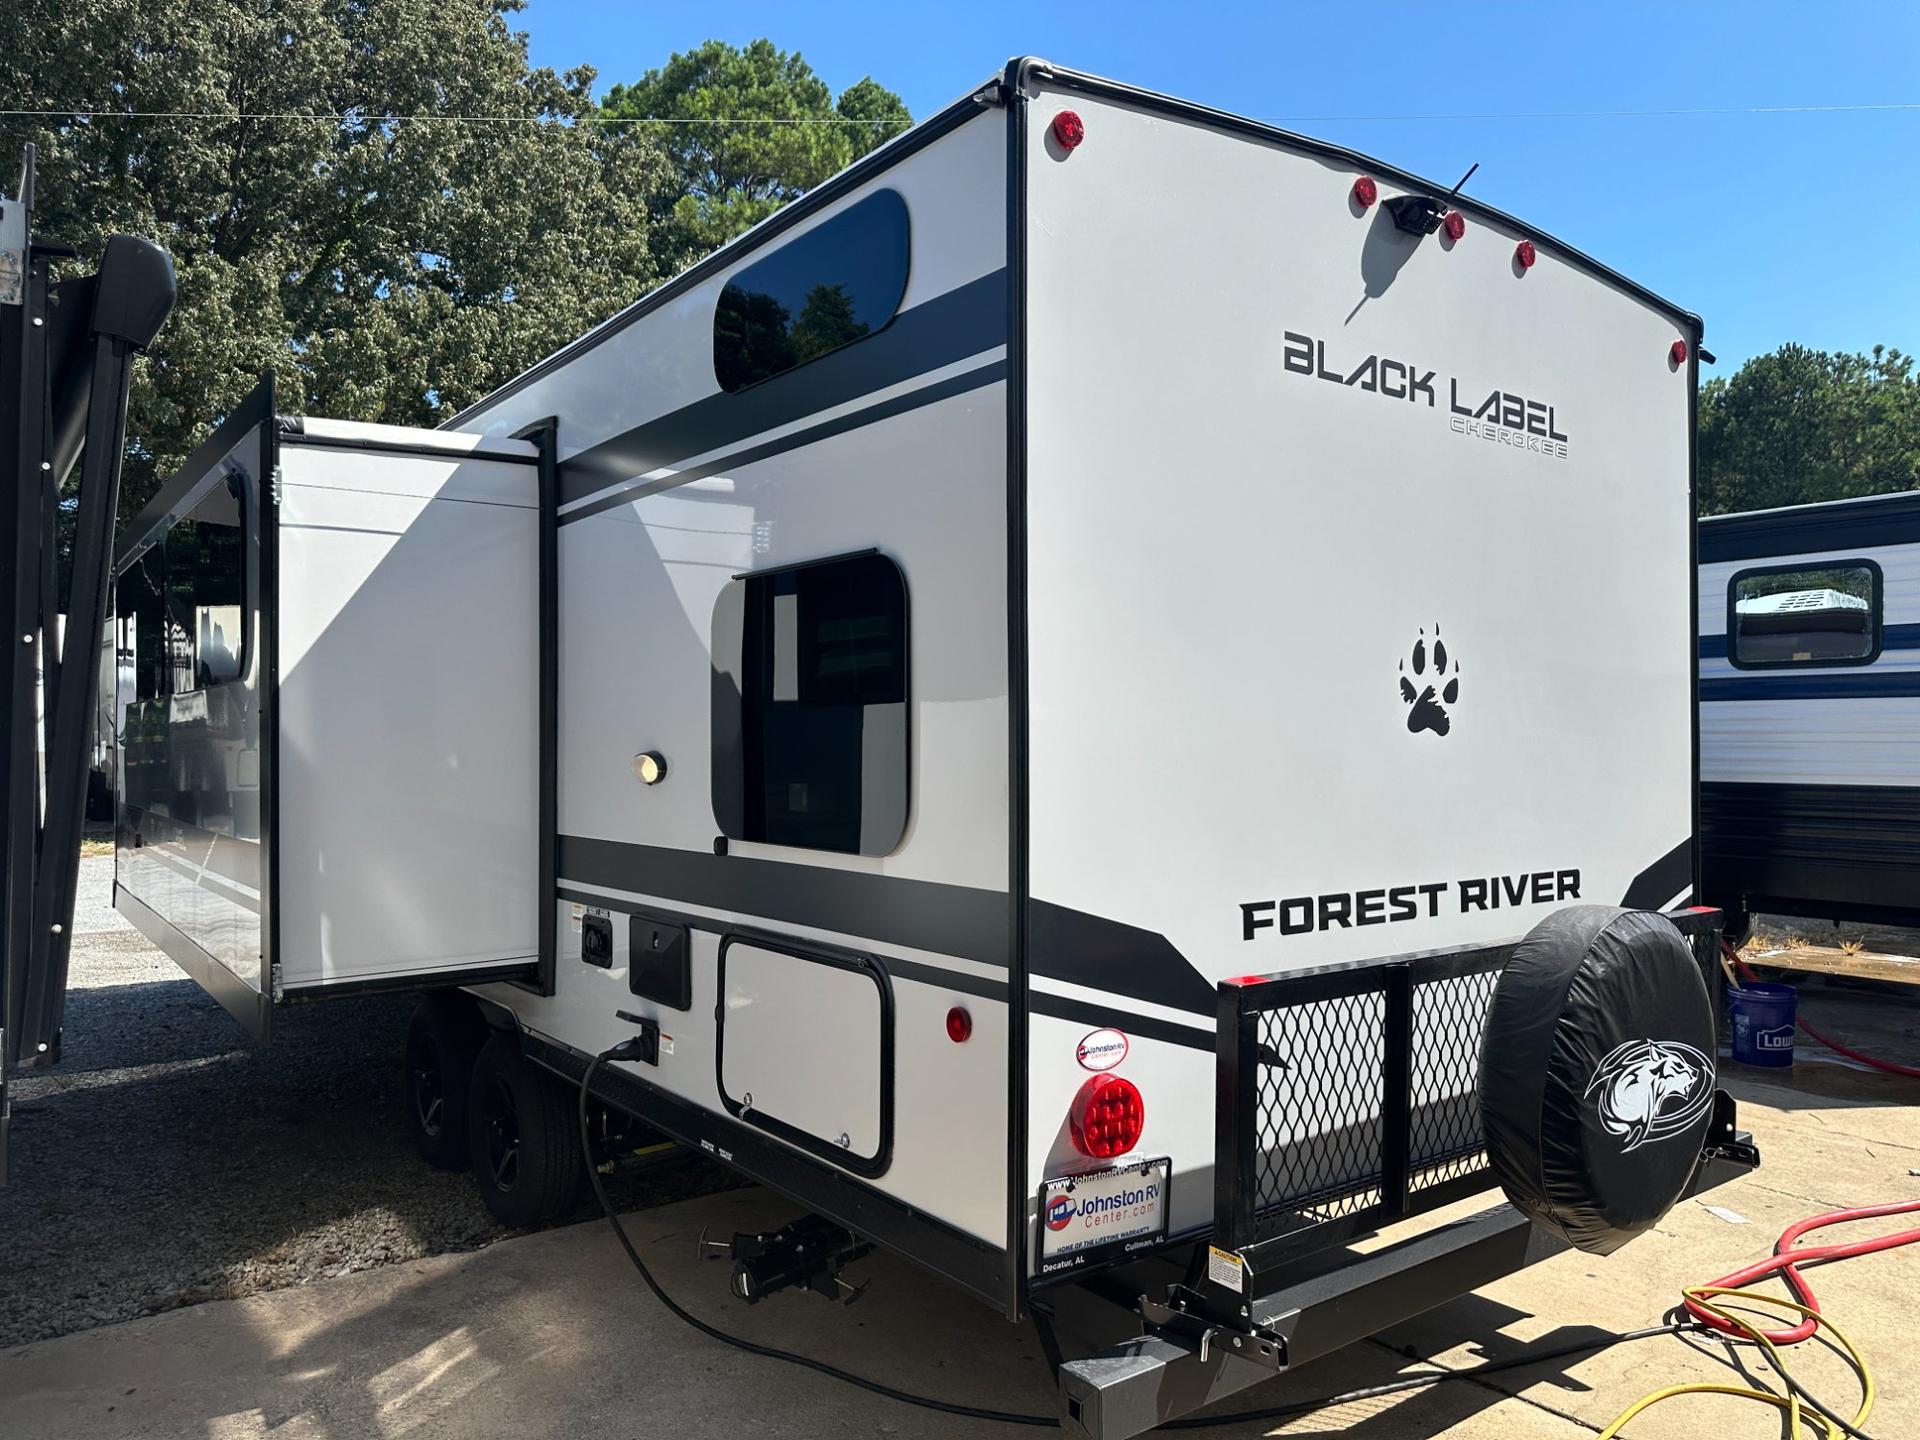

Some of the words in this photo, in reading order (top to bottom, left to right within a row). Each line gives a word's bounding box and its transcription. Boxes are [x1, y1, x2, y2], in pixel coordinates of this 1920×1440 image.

[1284, 330, 1437, 407] BLACK
[1450, 377, 1568, 443] LABEL
[1450, 416, 1568, 459] CHEROKEE
[1239, 882, 1448, 941] FOREST
[1457, 868, 1581, 913] RIVER
[1077, 1190, 1144, 1217] Johnston
[1146, 1183, 1160, 1200] RV
[1085, 1202, 1155, 1228] Center.com
[1057, 1243, 1074, 1253] HOME
[1074, 1241, 1083, 1250] OF
[1083, 1238, 1094, 1247] THE
[1120, 1226, 1150, 1238] WARRANTY
[1155, 1235, 1165, 1244] AL
[1043, 1260, 1074, 1273] Decatur,
[1075, 1256, 1085, 1265] AL
